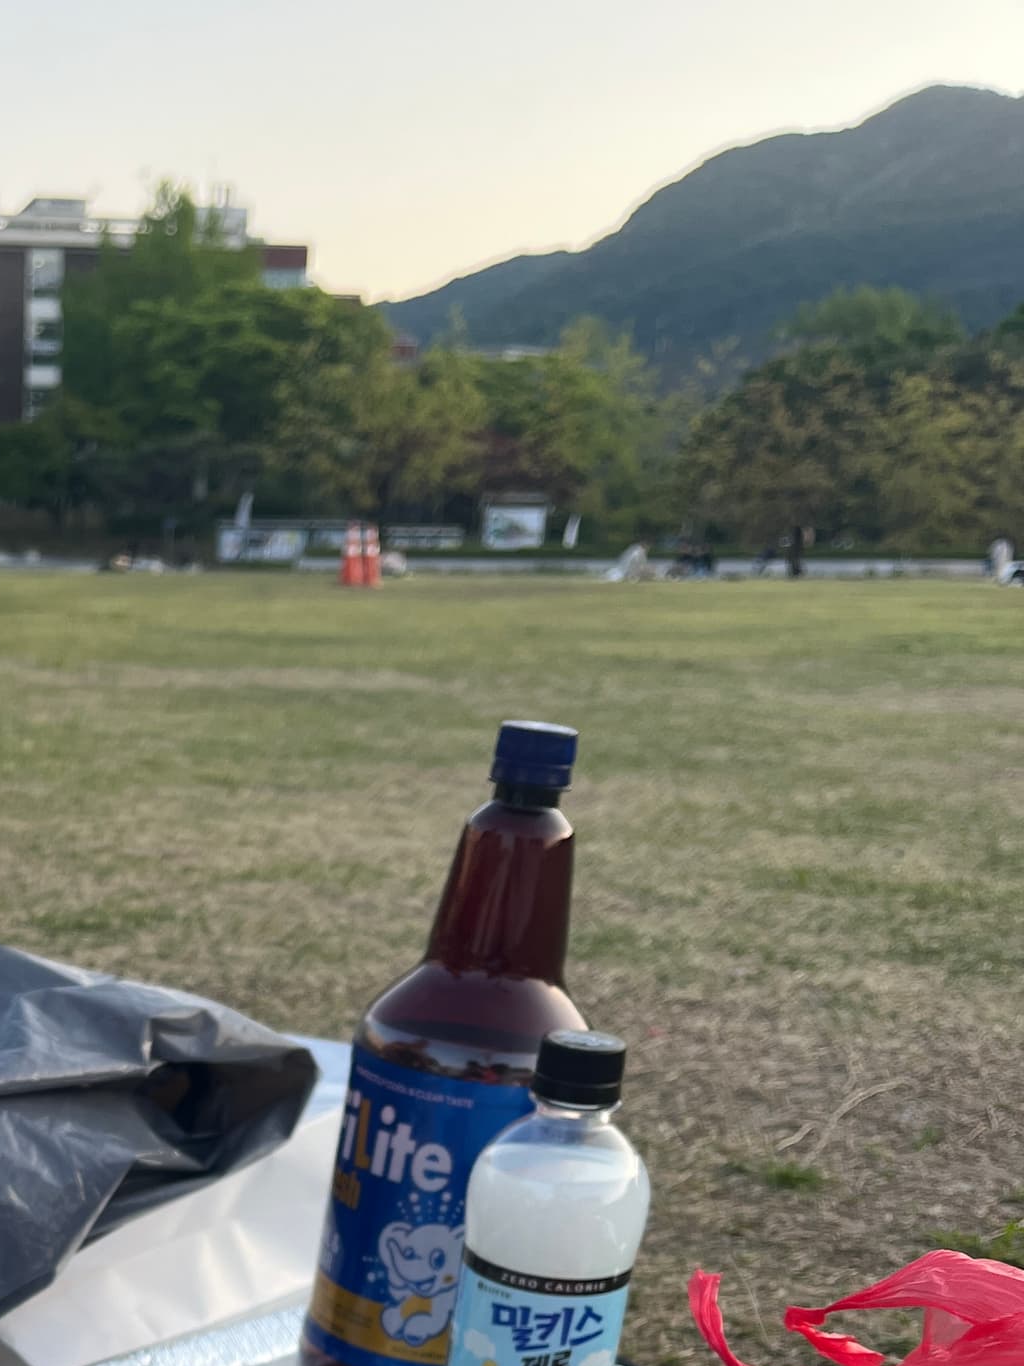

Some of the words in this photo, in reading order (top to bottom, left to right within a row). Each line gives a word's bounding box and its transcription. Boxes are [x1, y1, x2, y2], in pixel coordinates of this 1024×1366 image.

[342, 1090, 452, 1193] iLite
[500, 1273, 538, 1289] ZERO
[544, 1280, 607, 1293] CALORIE
[491, 1302, 604, 1352] 밀키스
